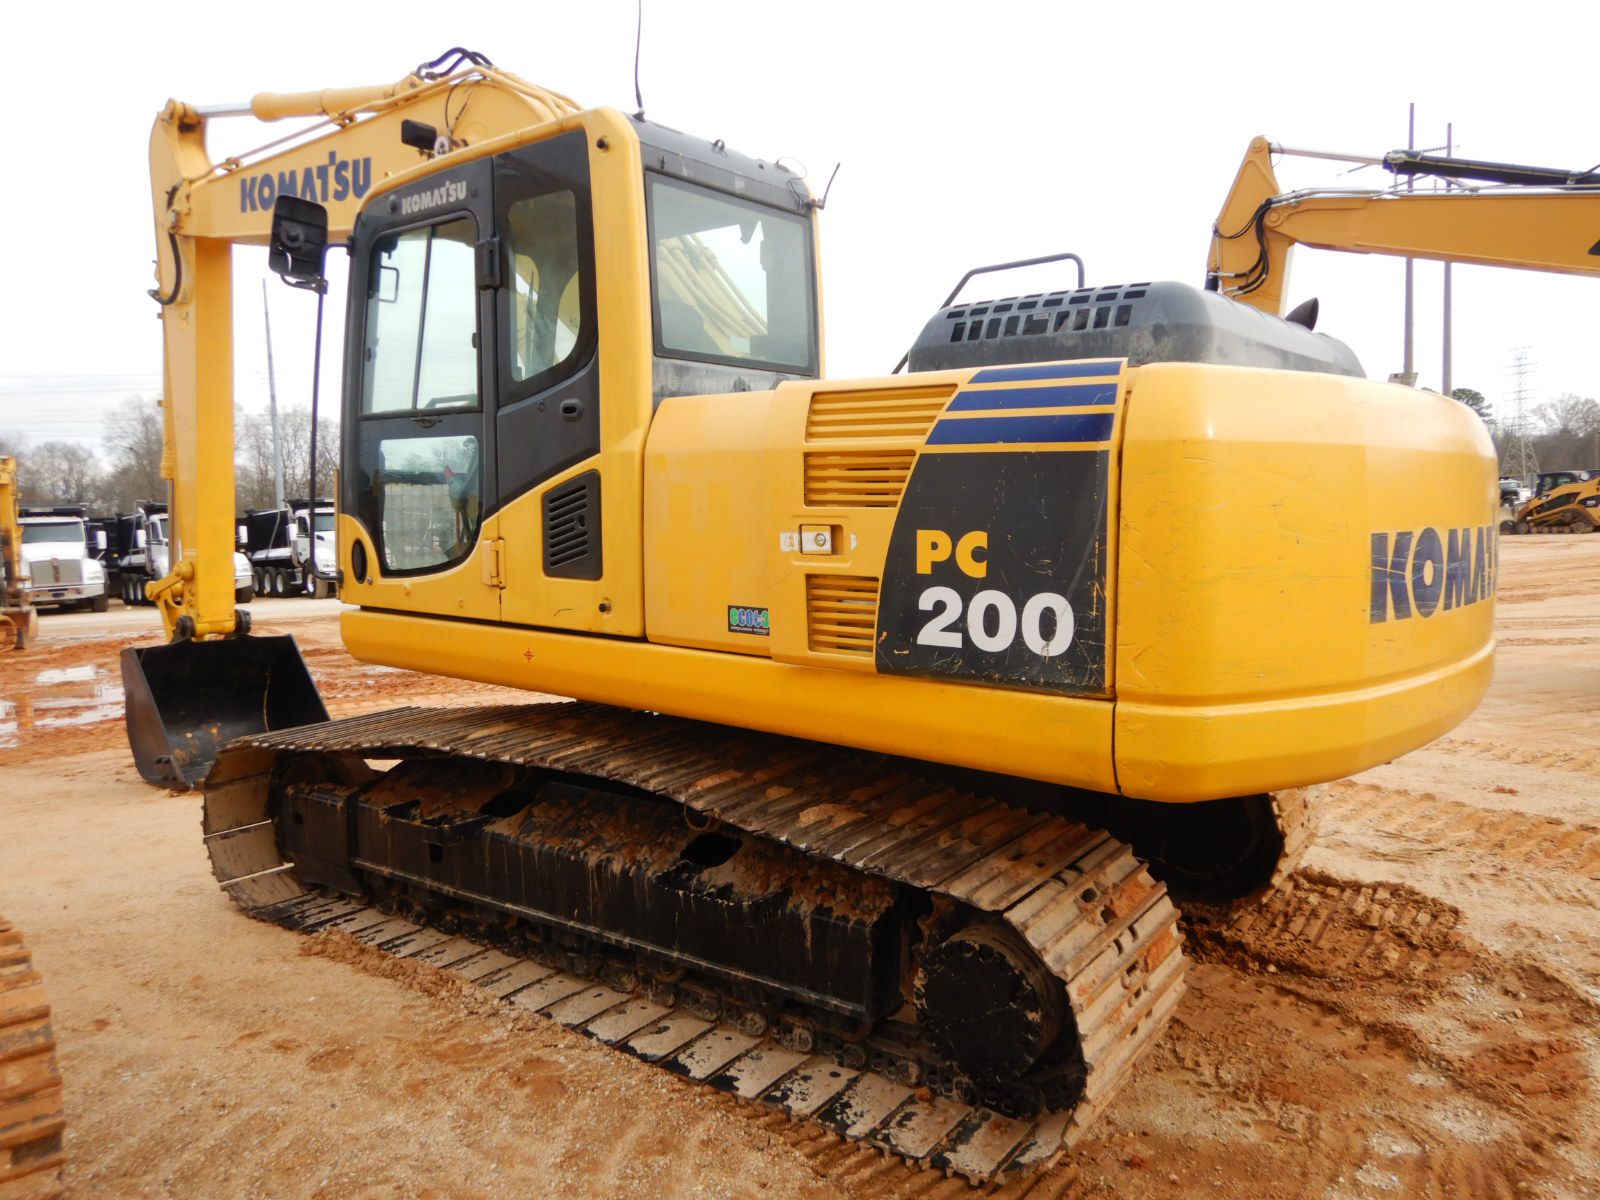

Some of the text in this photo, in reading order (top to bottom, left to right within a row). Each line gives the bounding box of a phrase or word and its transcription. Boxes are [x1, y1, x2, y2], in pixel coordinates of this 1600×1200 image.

[239, 150, 371, 213] KOMATSU
[402, 181, 467, 215] KOMATSU
[916, 529, 988, 579] PC
[916, 586, 1075, 658] 200
